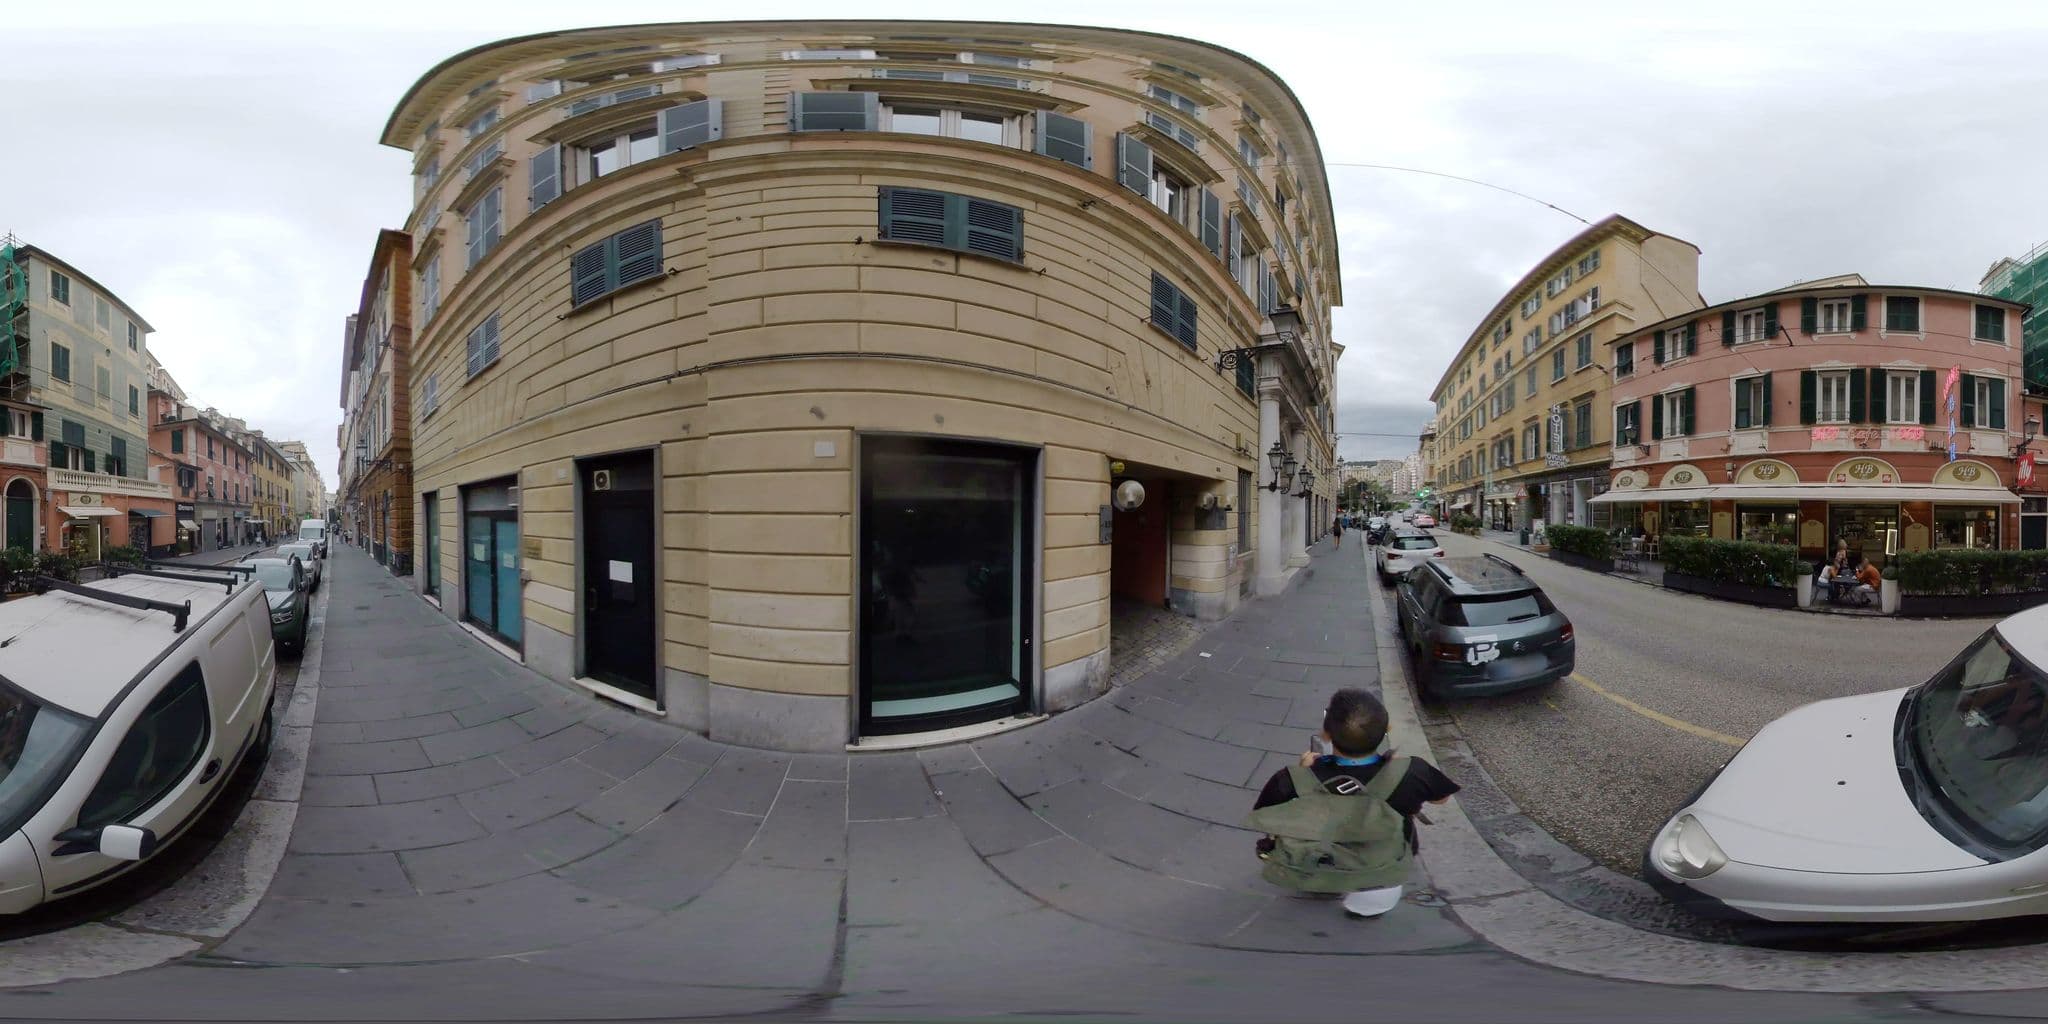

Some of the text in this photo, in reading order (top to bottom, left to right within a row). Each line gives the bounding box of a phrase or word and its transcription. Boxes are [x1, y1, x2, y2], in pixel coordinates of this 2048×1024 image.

[1552, 403, 1561, 453] HOTEL
[1758, 464, 1775, 474] HB
[1855, 464, 1873, 474] HB
[1956, 466, 1976, 476] HB
[2018, 459, 2032, 483] illy
